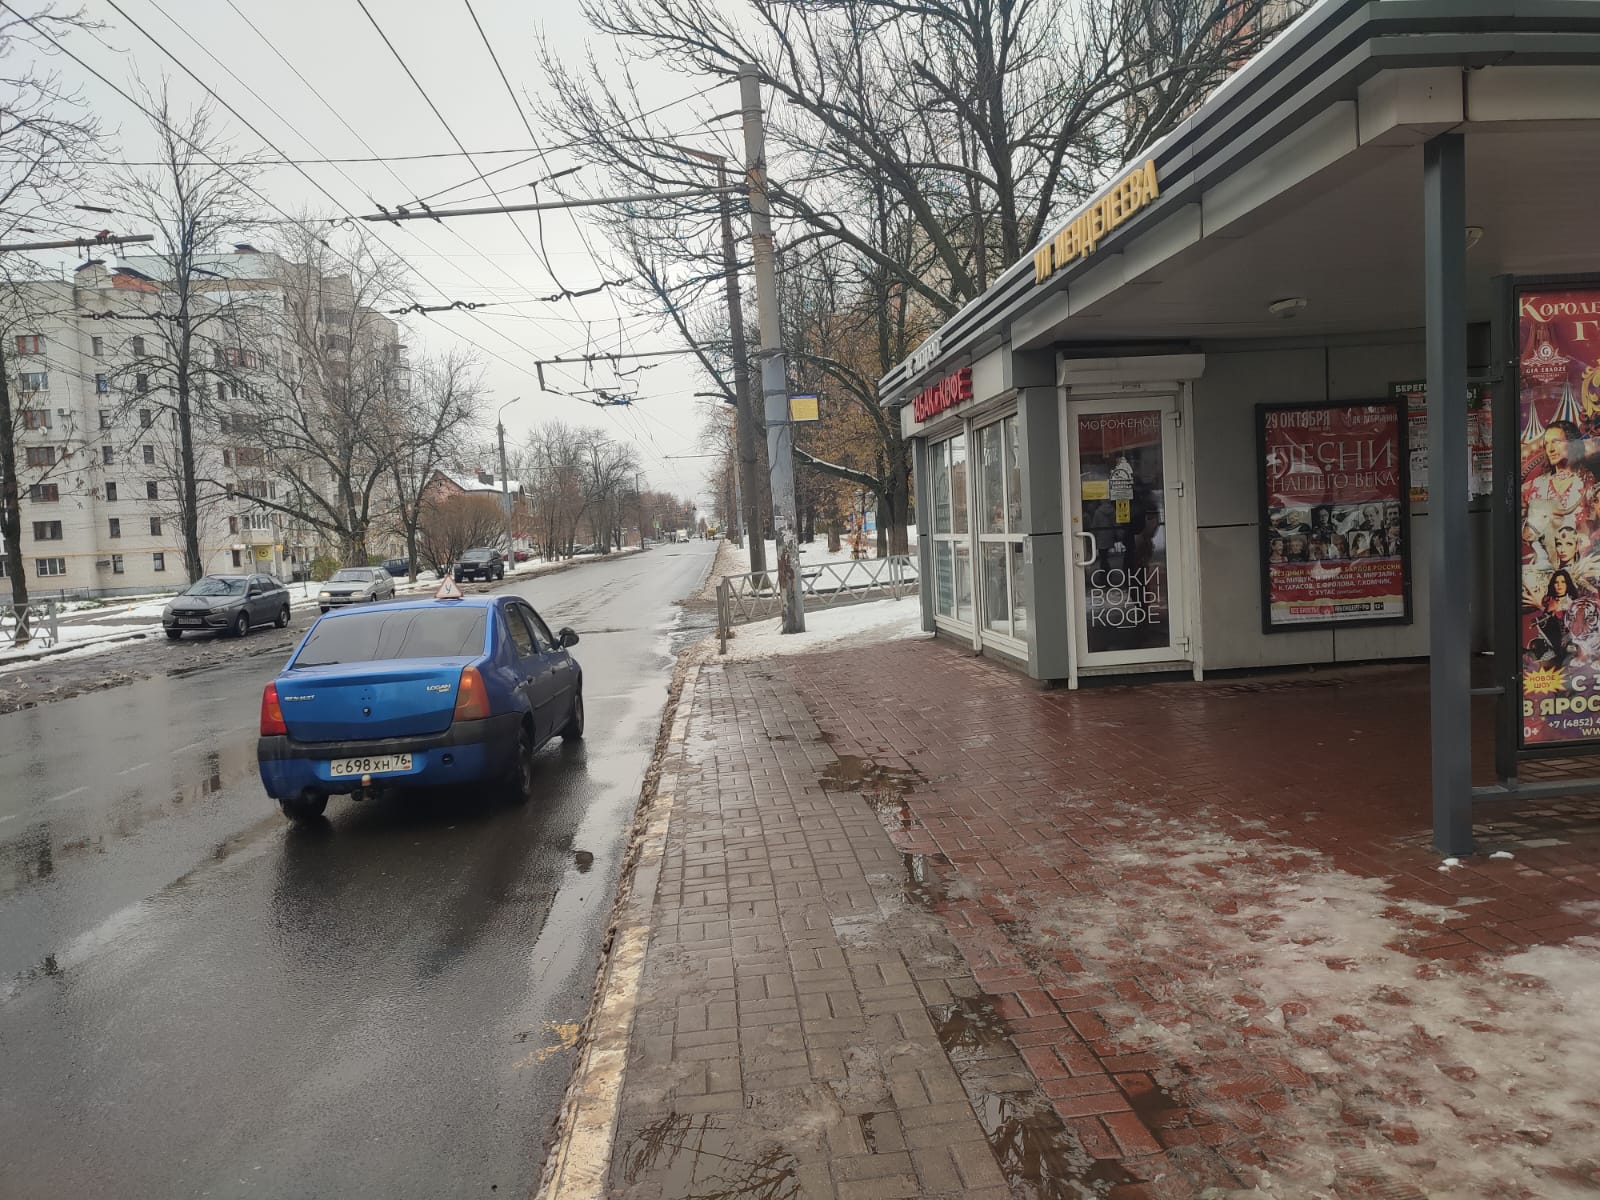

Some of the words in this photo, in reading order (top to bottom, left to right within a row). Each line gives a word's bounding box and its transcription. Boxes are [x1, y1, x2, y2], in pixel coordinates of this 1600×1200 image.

[1054, 159, 1159, 270] МЕНДЕЛЕЕВА
[939, 367, 973, 410] КОФЕ
[1080, 416, 1160, 431] МОРОЖЕНОЕ
[1265, 414, 1278, 429] 29
[1280, 410, 1330, 428] ОКТЯБРЯ
[1271, 438, 1393, 475] ПЕСНИ
[1271, 473, 1349, 493] НАШЕГО
[1355, 471, 1397, 488] ВЕКА
[1091, 567, 1160, 588] СОКИ
[1091, 586, 1160, 608] ВОДЫ
[1091, 605, 1161, 627] КОФЕ
[1529, 674, 1556, 682] НОВОЕ
[1540, 695, 1600, 715] ЯРОС
[1563, 717, 1593, 728] (4852)
[336, 758, 390, 775] С698ХН
[394, 755, 408, 766] 76
